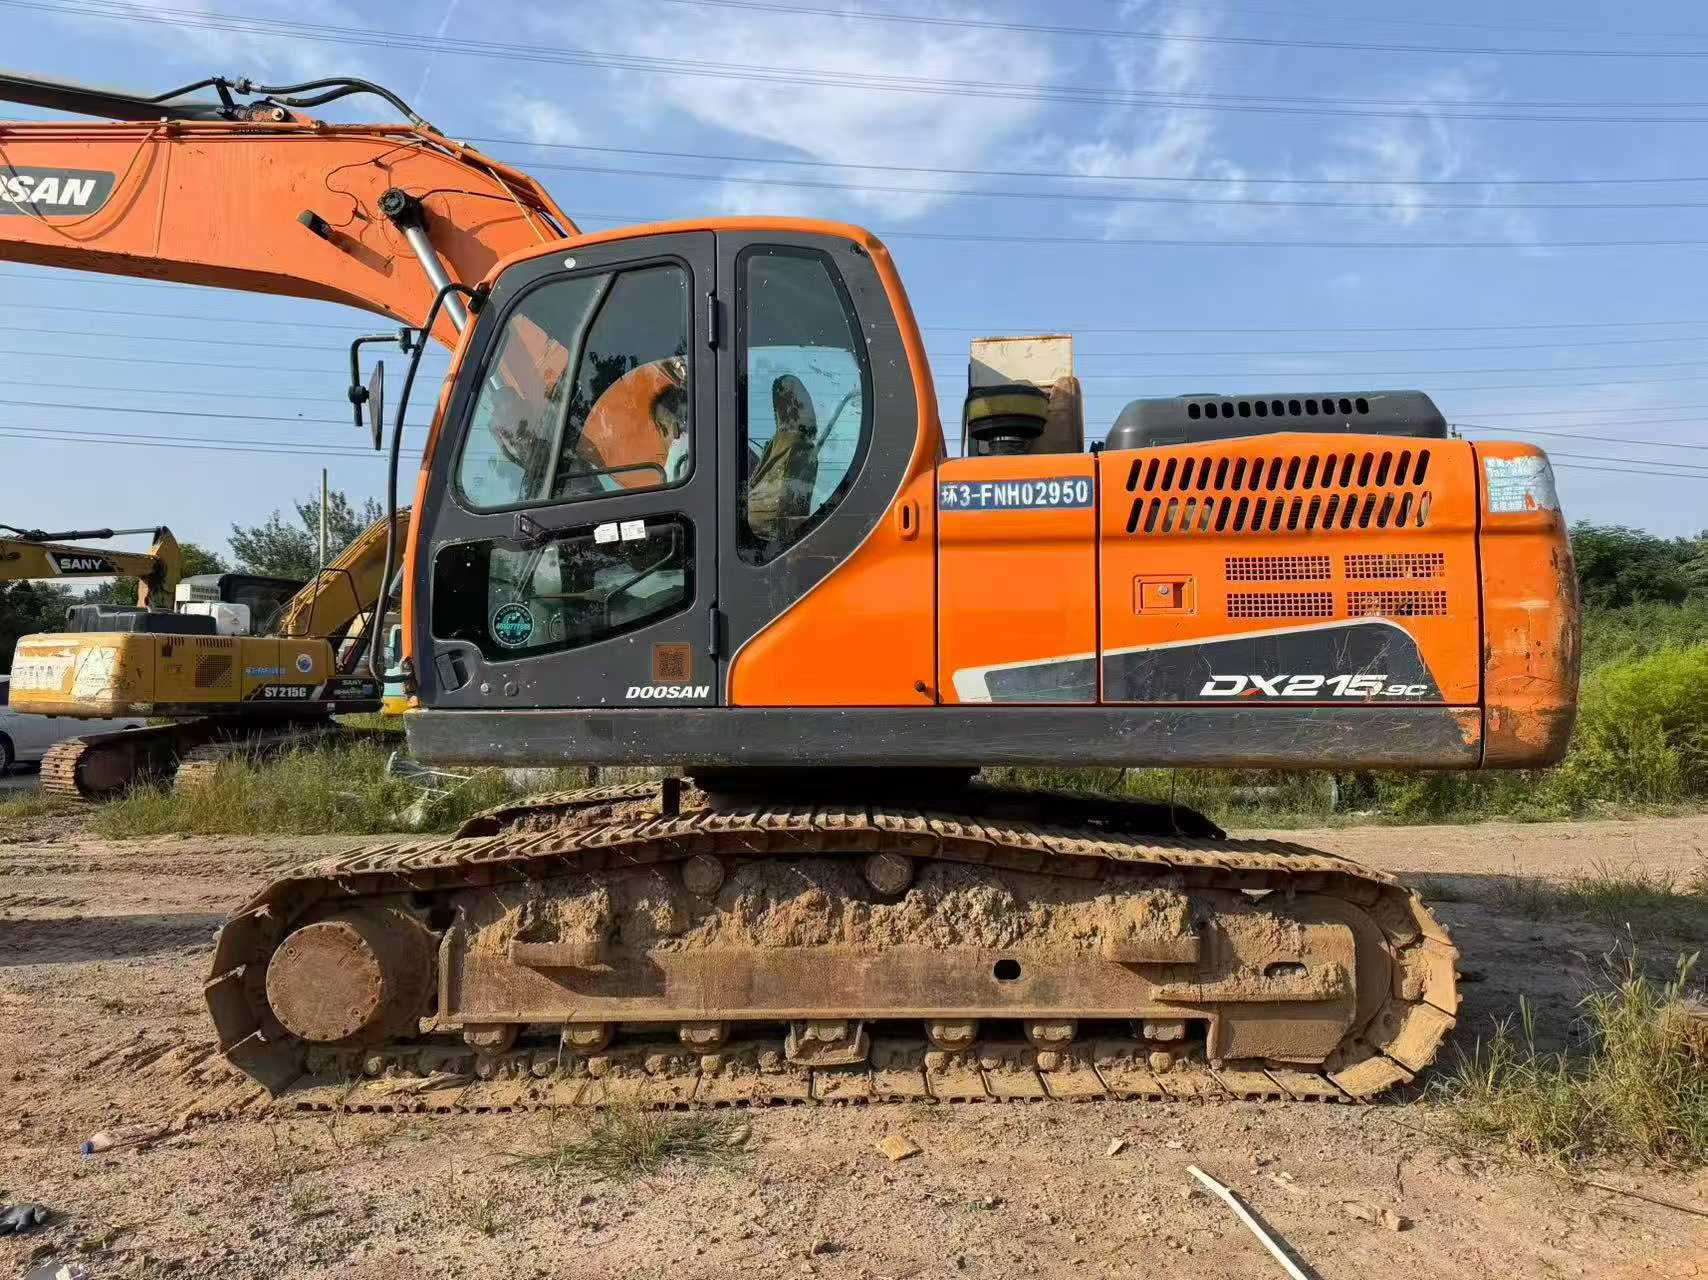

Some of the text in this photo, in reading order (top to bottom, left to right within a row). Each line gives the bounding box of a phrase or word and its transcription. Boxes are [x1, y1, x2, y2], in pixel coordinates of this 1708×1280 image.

[941, 480, 1089, 507] 环3-FNH02950
[60, 558, 102, 570] SANY
[625, 685, 710, 699] DOOSAN
